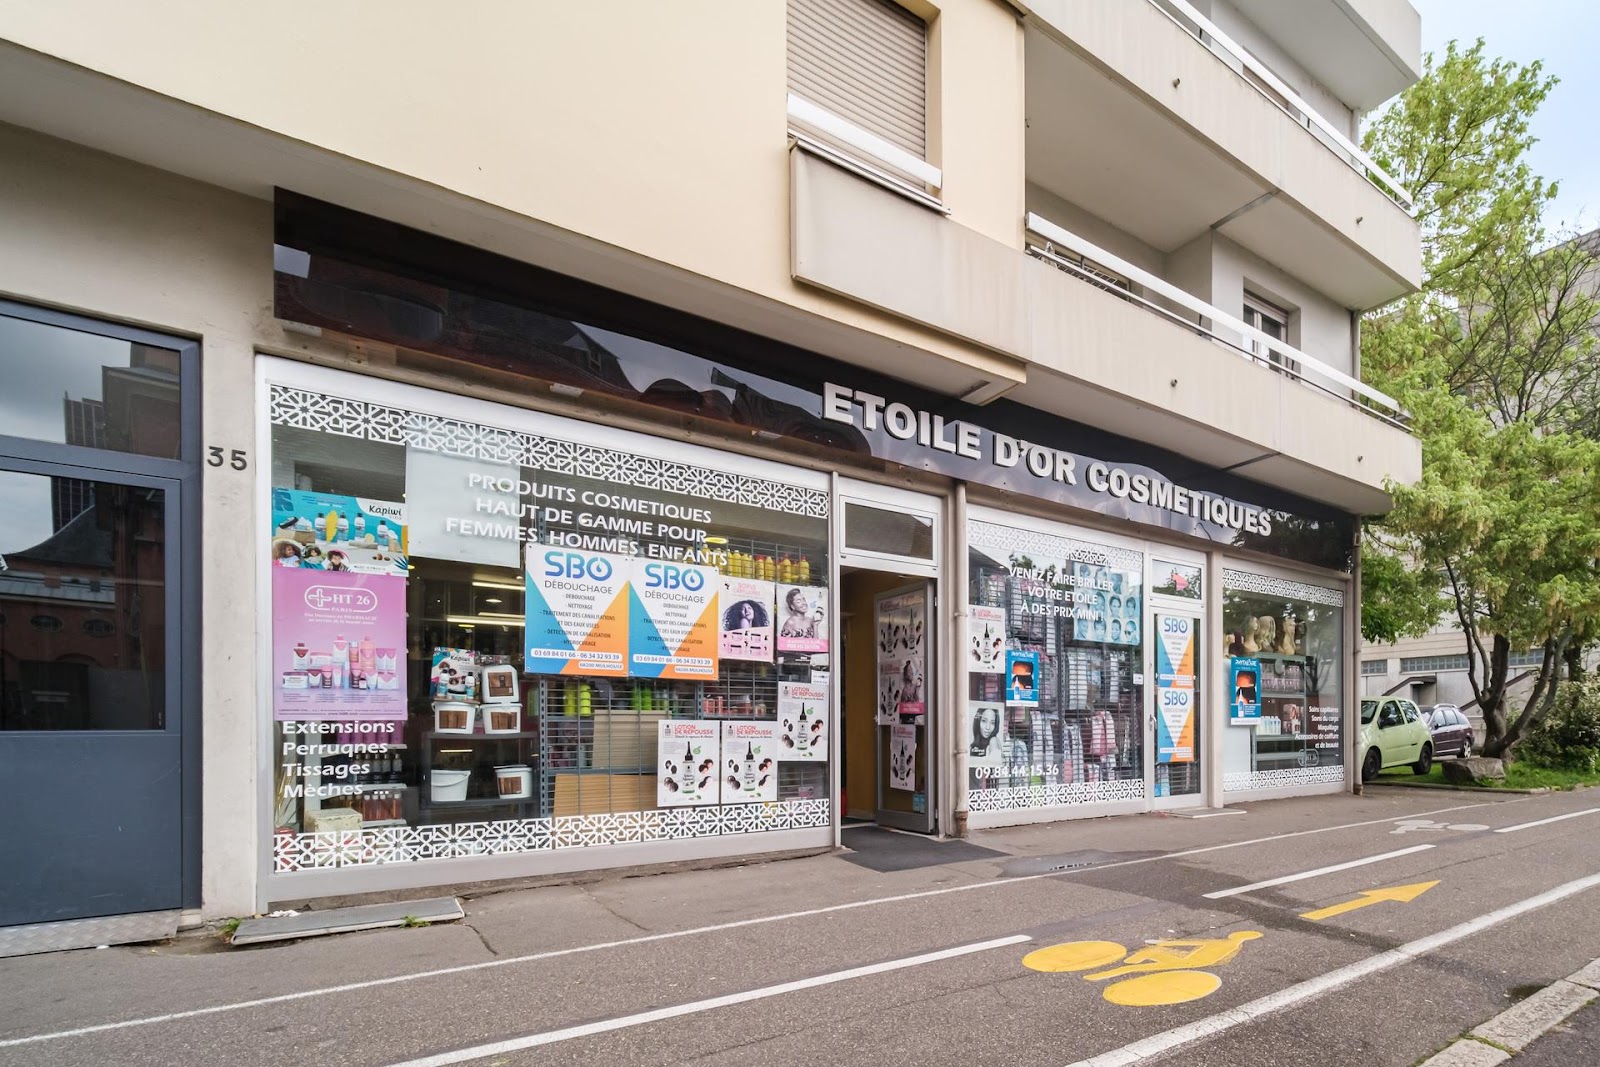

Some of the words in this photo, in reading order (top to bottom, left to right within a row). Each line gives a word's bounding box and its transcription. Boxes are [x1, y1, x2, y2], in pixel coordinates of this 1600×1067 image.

[207, 446, 247, 471] 35
[822, 382, 981, 460] ETOILE
[1086, 462, 1271, 537] COSMETIQUES
[468, 473, 576, 503] PRODUITS
[581, 491, 712, 524] COSMETIQUES
[369, 505, 402, 516] Kapiwi
[476, 497, 539, 519] HAUT
[545, 507, 573, 525] DE
[578, 513, 653, 536] GAMME
[658, 524, 707, 543] POUR
[446, 517, 538, 542] FEMMES
[549, 530, 639, 555] HOMMES
[648, 543, 728, 566] ENFANTS
[544, 551, 613, 581] SBO
[645, 563, 704, 591] SBO
[1009, 567, 1045, 582] VENEZ
[1047, 572, 1075, 586] FAIRE
[1078, 577, 1113, 591] BRILLER
[544, 580, 613, 594] DÉBOUCHAGE
[332, 593, 353, 604] HT
[357, 595, 370, 605] 26
[645, 590, 704, 603] DÉBOUCHAGE
[1027, 586, 1062, 600] VOTRE
[1065, 591, 1098, 605] ETOILE
[543, 610, 571, 618] TRAITEMENT
[1020, 599, 1029, 613] À
[1031, 603, 1051, 615] DES
[1054, 606, 1074, 618] PRIX
[1077, 609, 1099, 621] MINI
[1164, 617, 1188, 633] SBO
[1164, 690, 1188, 706] SBO
[282, 721, 395, 734] Extensions
[282, 763, 370, 779] Tissages
[975, 764, 1059, 779] 09.84.44.15.36
[283, 783, 363, 798] Mèches
